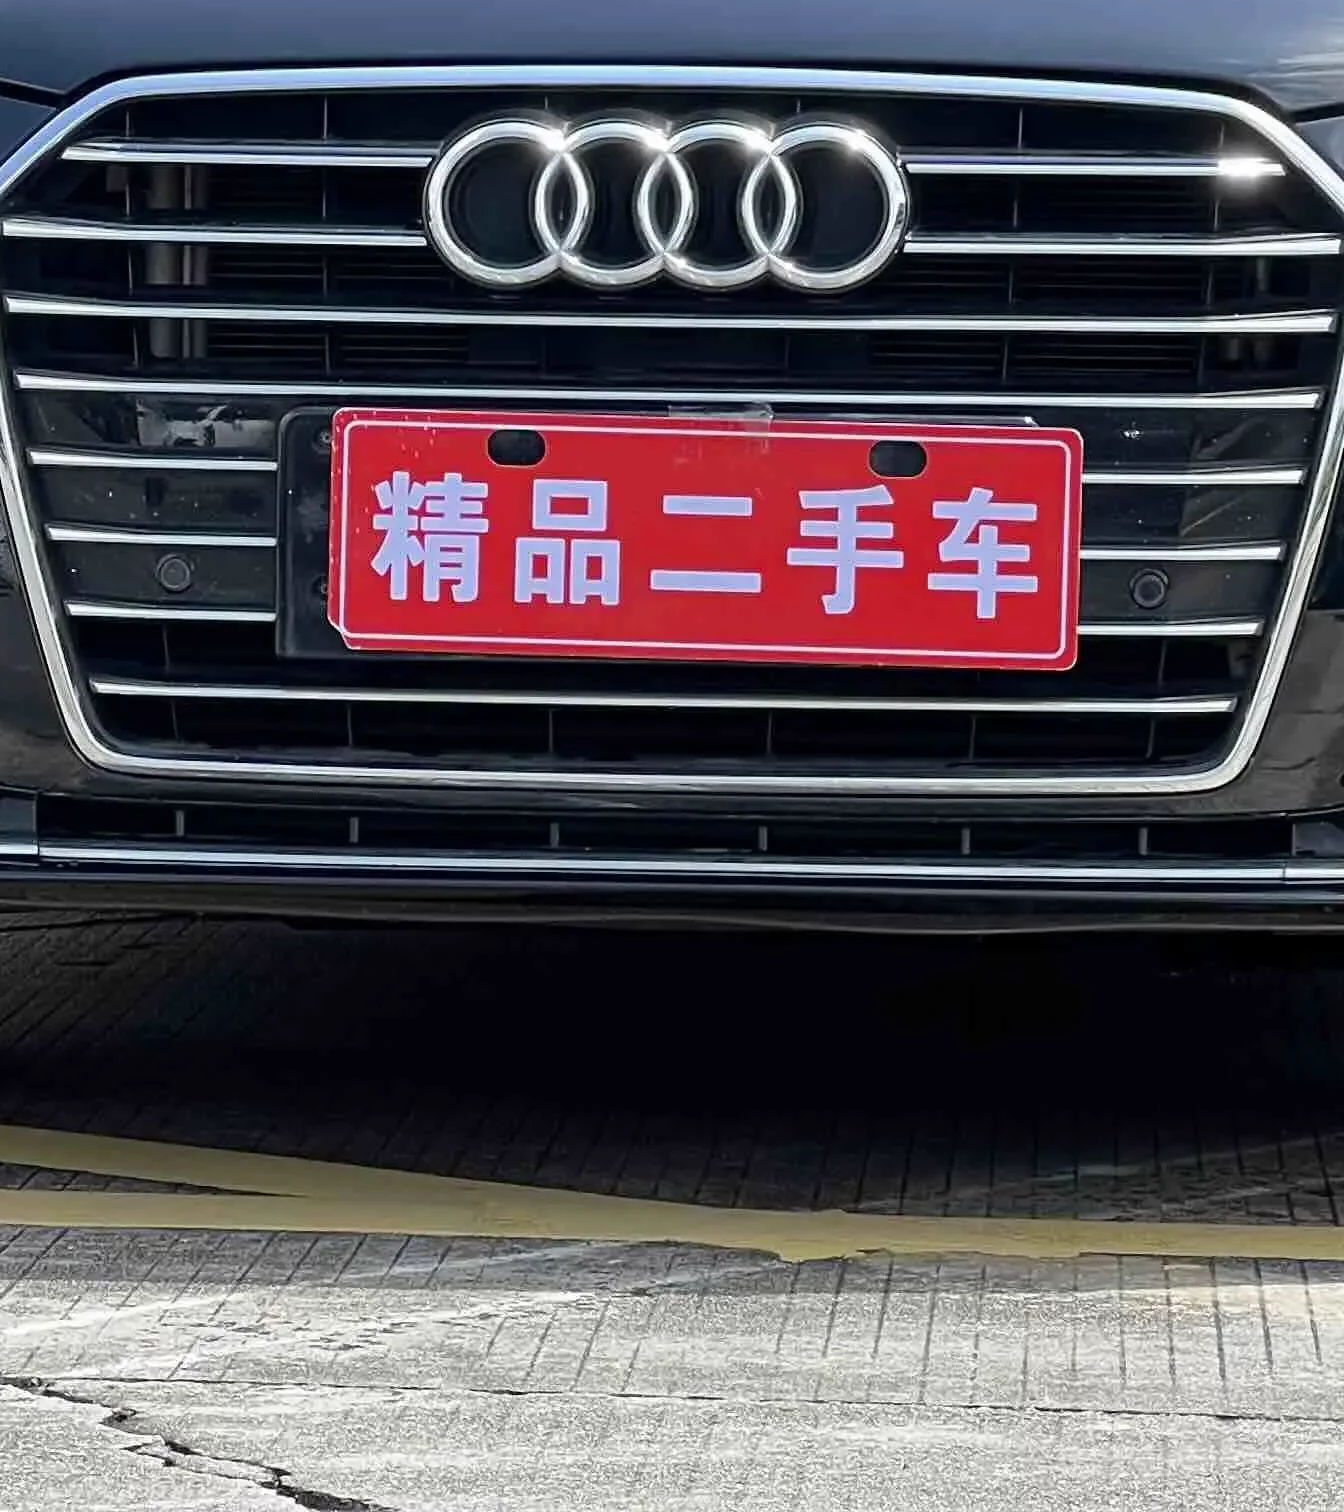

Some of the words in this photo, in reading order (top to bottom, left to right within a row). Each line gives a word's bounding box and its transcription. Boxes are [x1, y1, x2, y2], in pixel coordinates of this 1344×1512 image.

[370, 470, 1039, 619] 精品二手车
